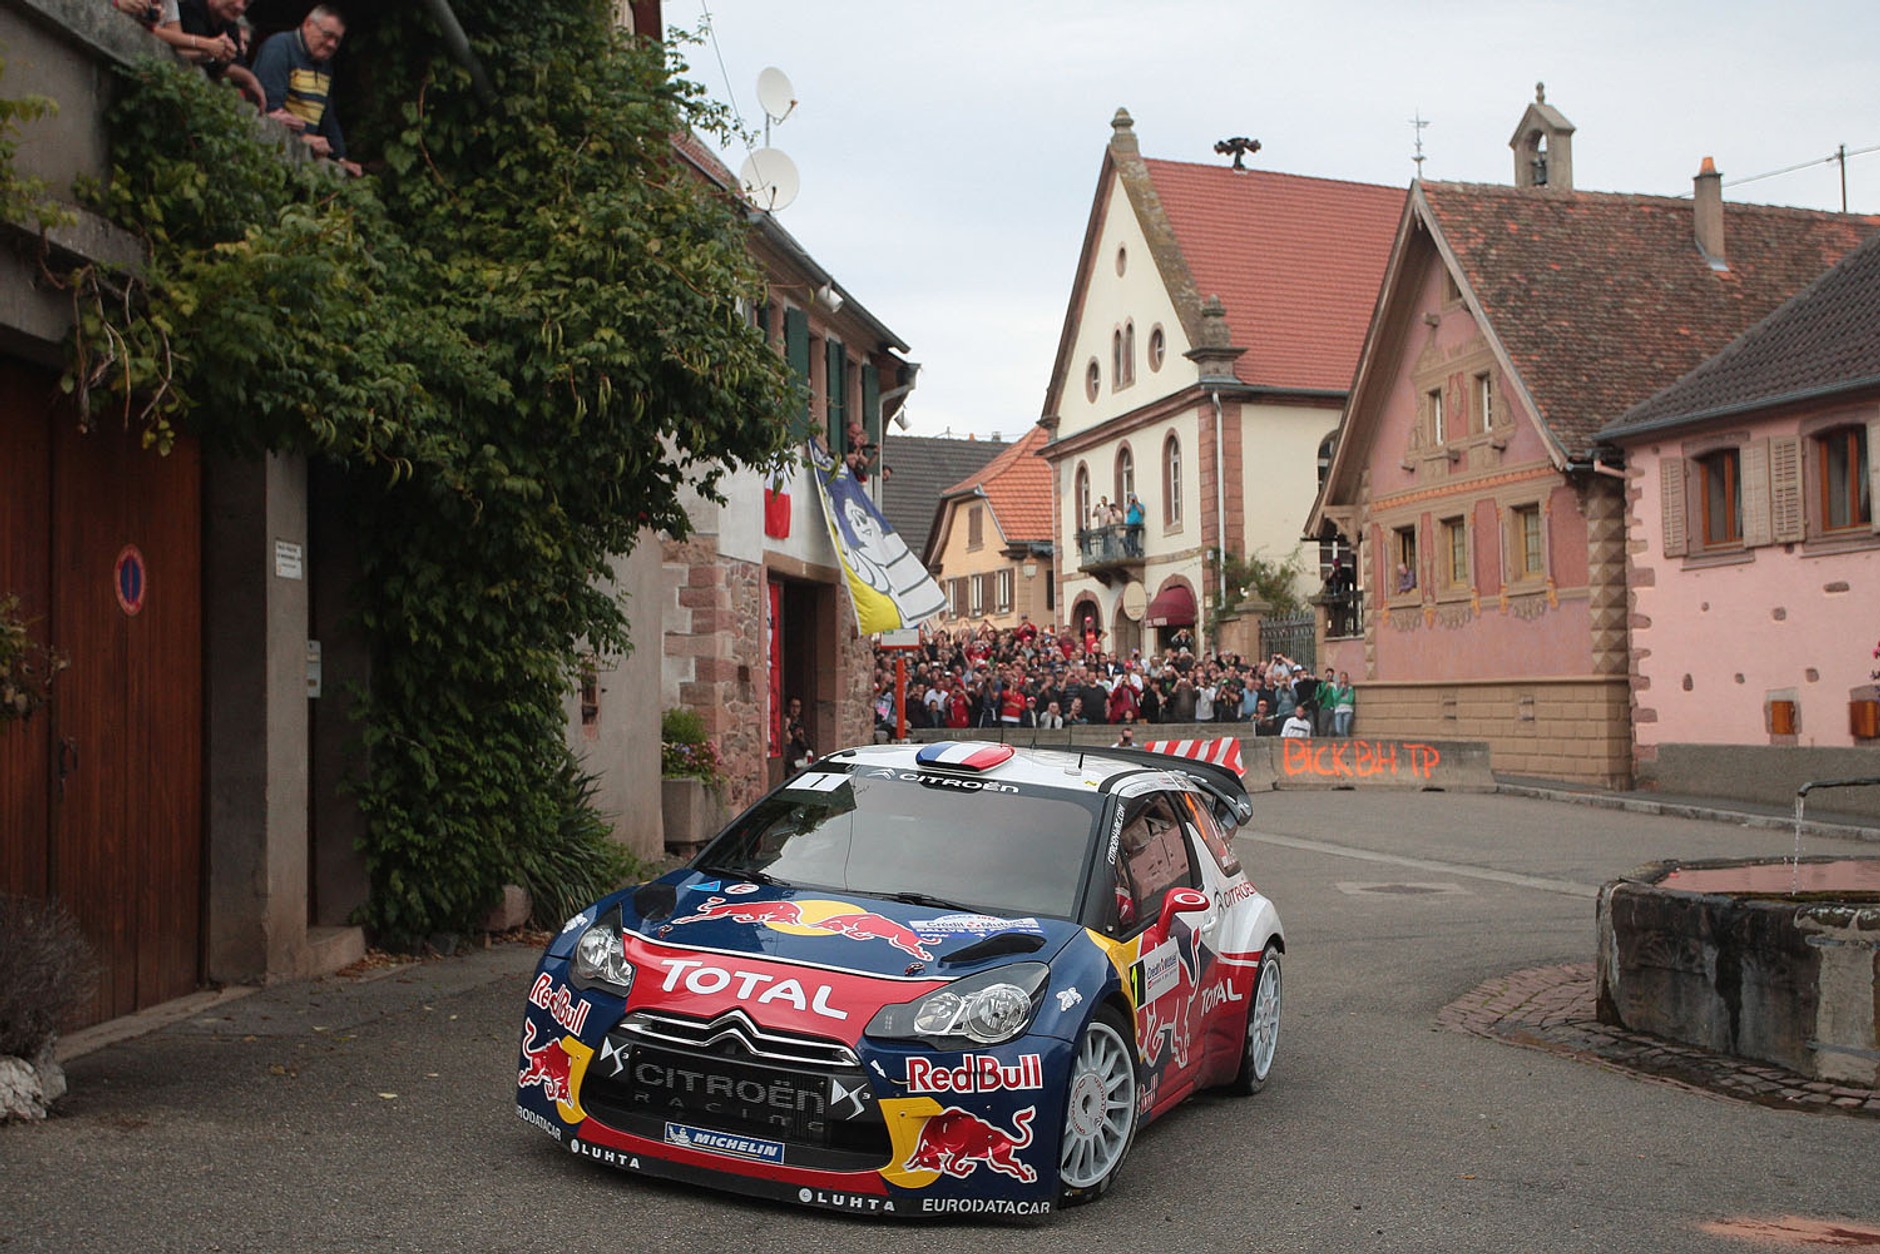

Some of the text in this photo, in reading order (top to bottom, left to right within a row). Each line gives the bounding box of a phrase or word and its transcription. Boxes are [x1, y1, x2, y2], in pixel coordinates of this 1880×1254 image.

[809, 774, 830, 788] 1
[899, 772, 1019, 793] CITROËN
[659, 959, 849, 1020] TOTAL
[1131, 965, 1138, 1009] 1
[1200, 978, 1243, 1017] TOTAL
[528, 971, 592, 1037] Red Bull
[634, 1063, 825, 1115] CITROËN
[905, 1053, 1043, 1094] Red Bull
[581, 1143, 640, 1169] LUHTA
[692, 1132, 778, 1157] MICHELIN
[817, 1191, 896, 1212] LUHTA
[922, 1198, 1051, 1215] EURODATACAR
